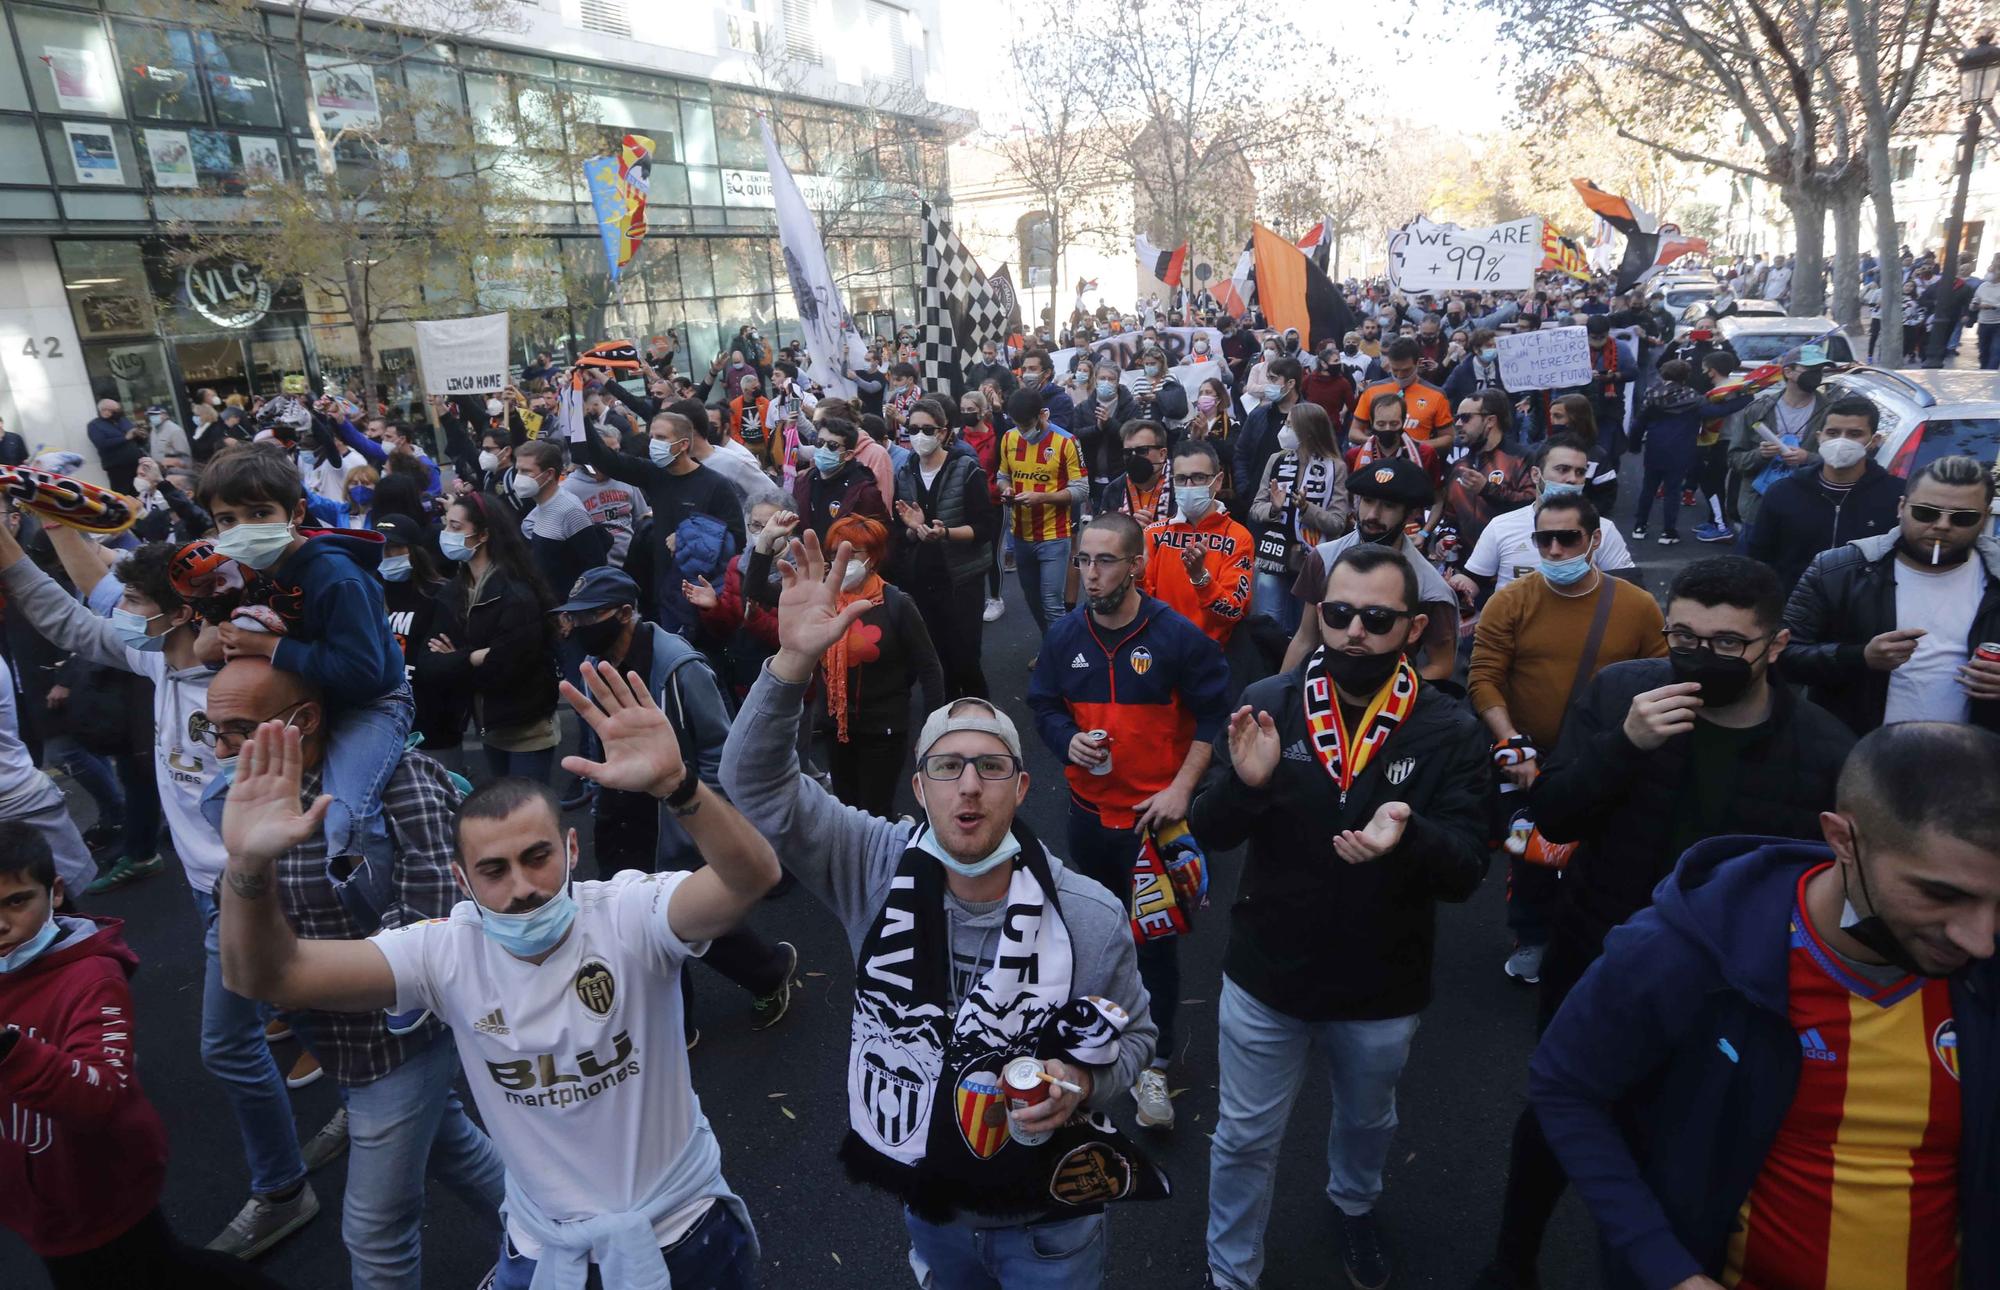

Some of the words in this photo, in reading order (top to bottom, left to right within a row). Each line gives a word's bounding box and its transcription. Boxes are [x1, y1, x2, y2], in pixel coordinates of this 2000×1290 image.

[1416, 229, 1452, 246] WE
[1487, 224, 1532, 244] ARE
[1447, 245, 1506, 282] 99%
[22, 336, 63, 359] 42
[1538, 341, 1586, 355] FUTURO
[112, 353, 138, 371] VLC
[384, 358, 400, 371] VLC
[1530, 352, 1588, 370] MEREZCO
[1260, 541, 1284, 557] 1919
[485, 1029, 633, 1090] BLU
